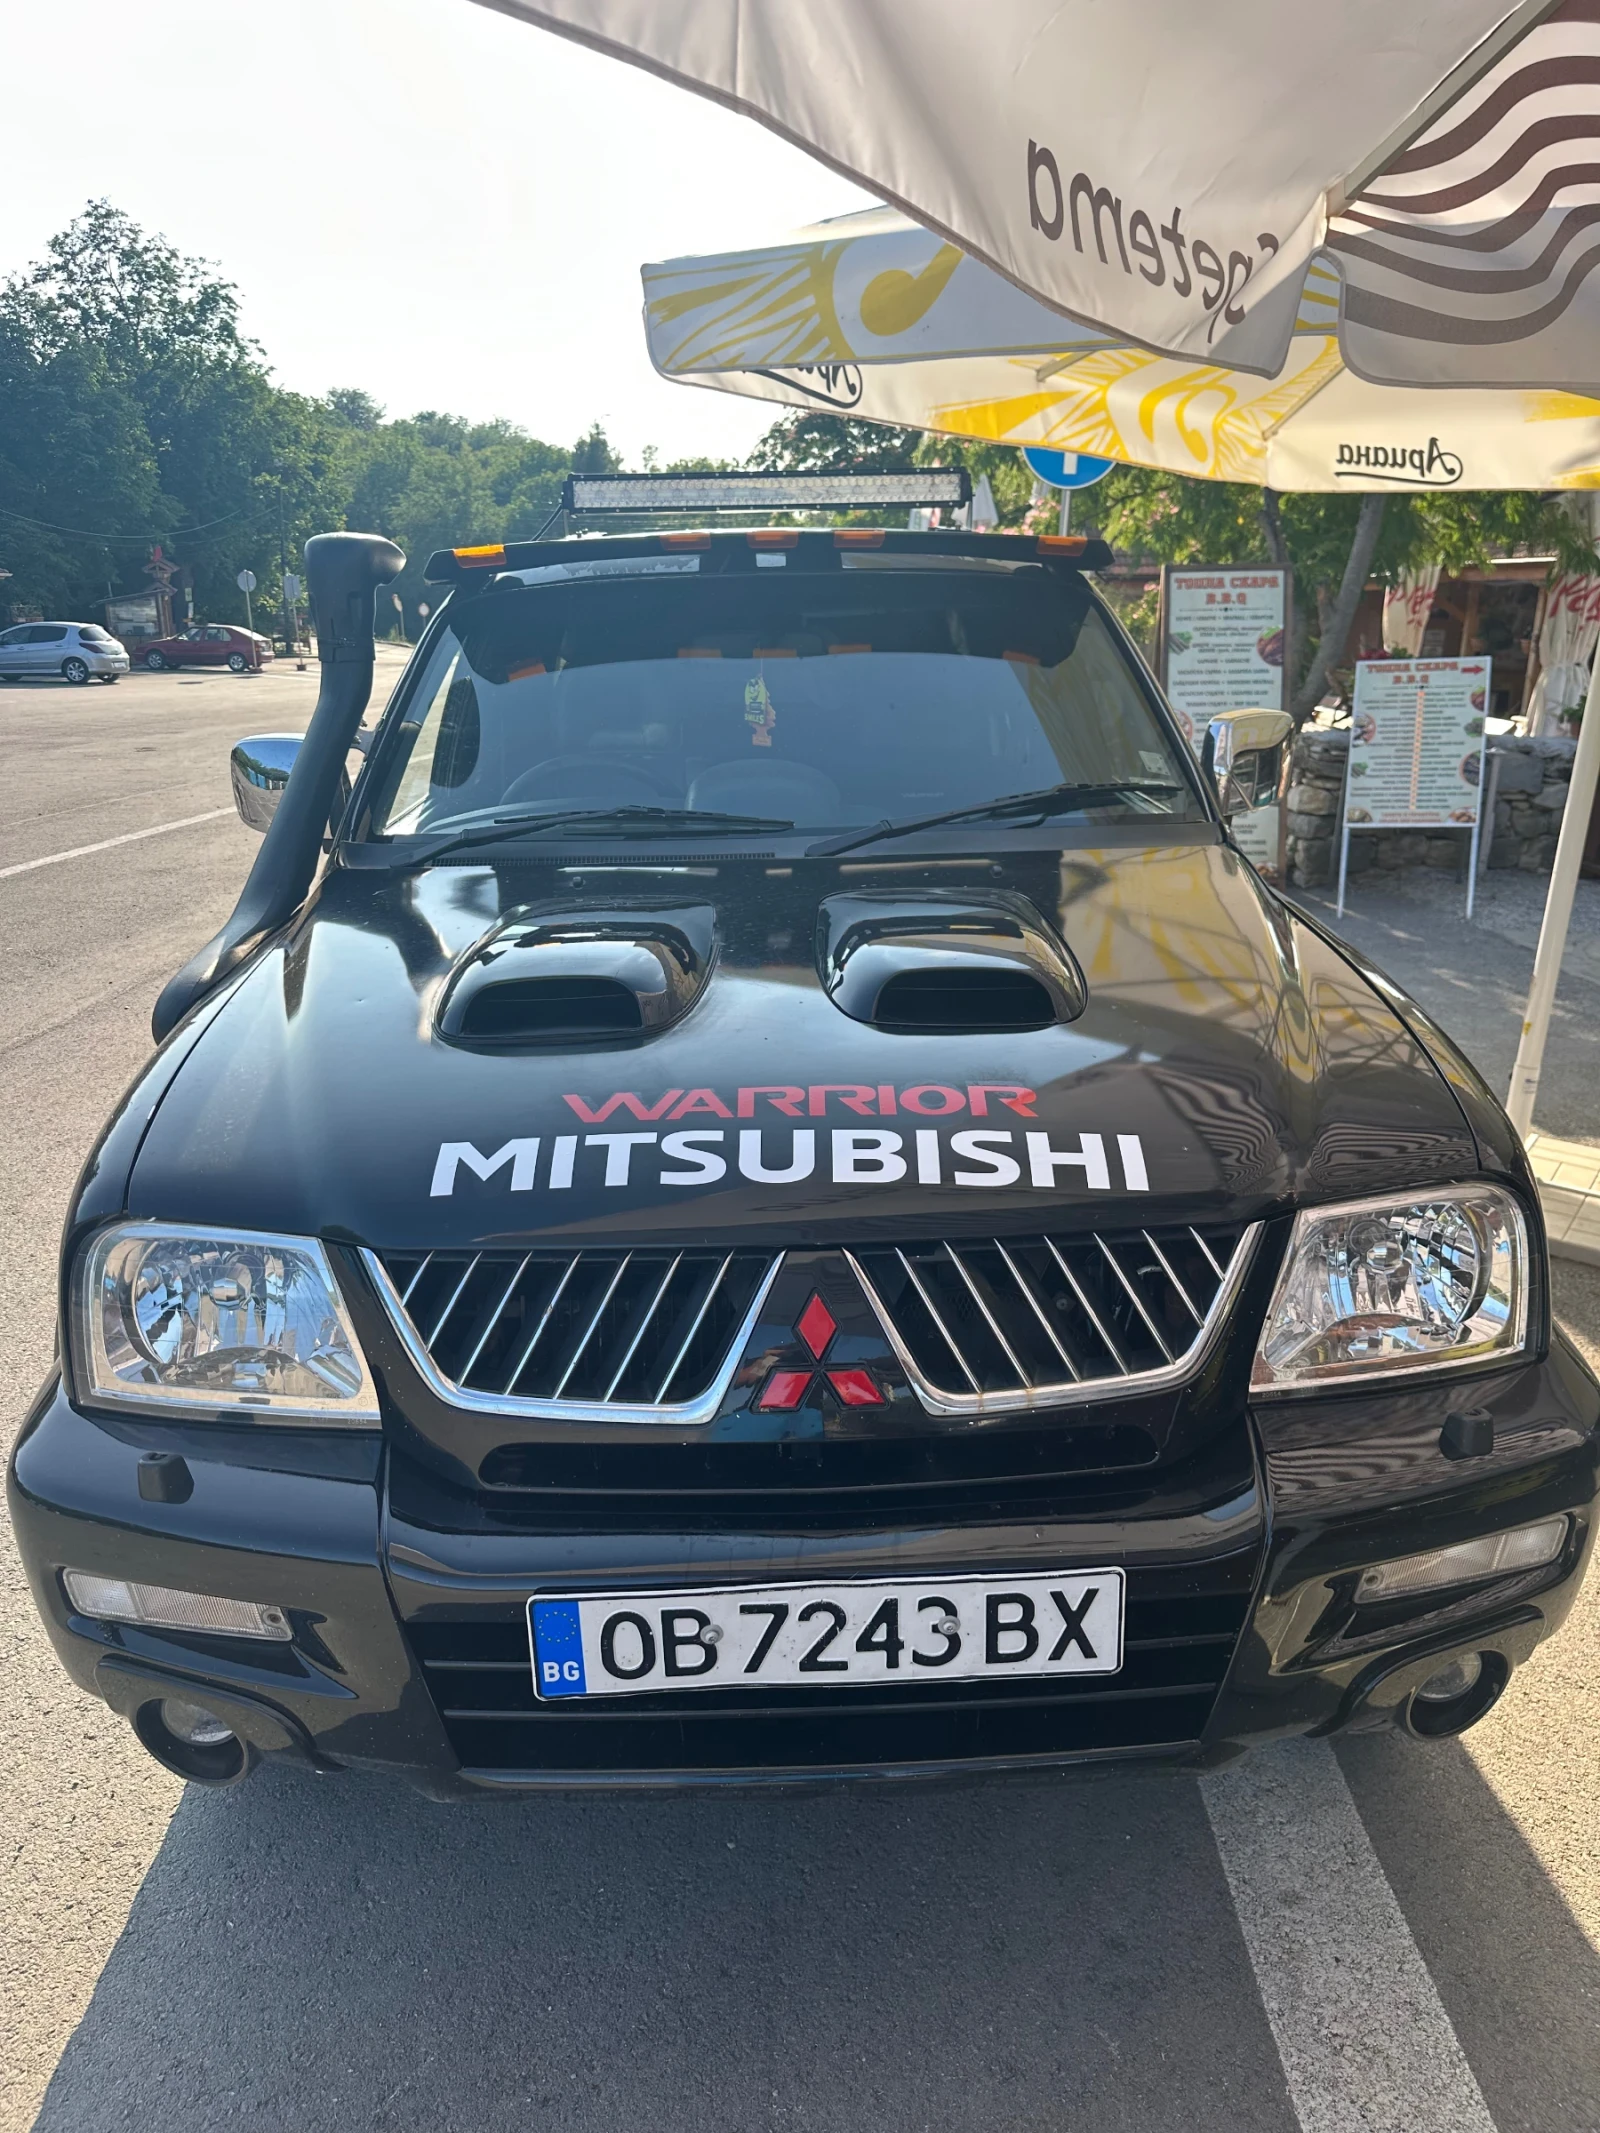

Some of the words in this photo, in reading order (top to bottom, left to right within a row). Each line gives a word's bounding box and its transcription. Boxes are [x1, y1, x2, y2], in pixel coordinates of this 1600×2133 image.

[562, 1085, 1038, 1123] WARRIOR
[429, 1129, 1149, 1197] MITSUBISHI
[542, 1660, 580, 1683] BG
[738, 1597, 963, 1674] 7243
